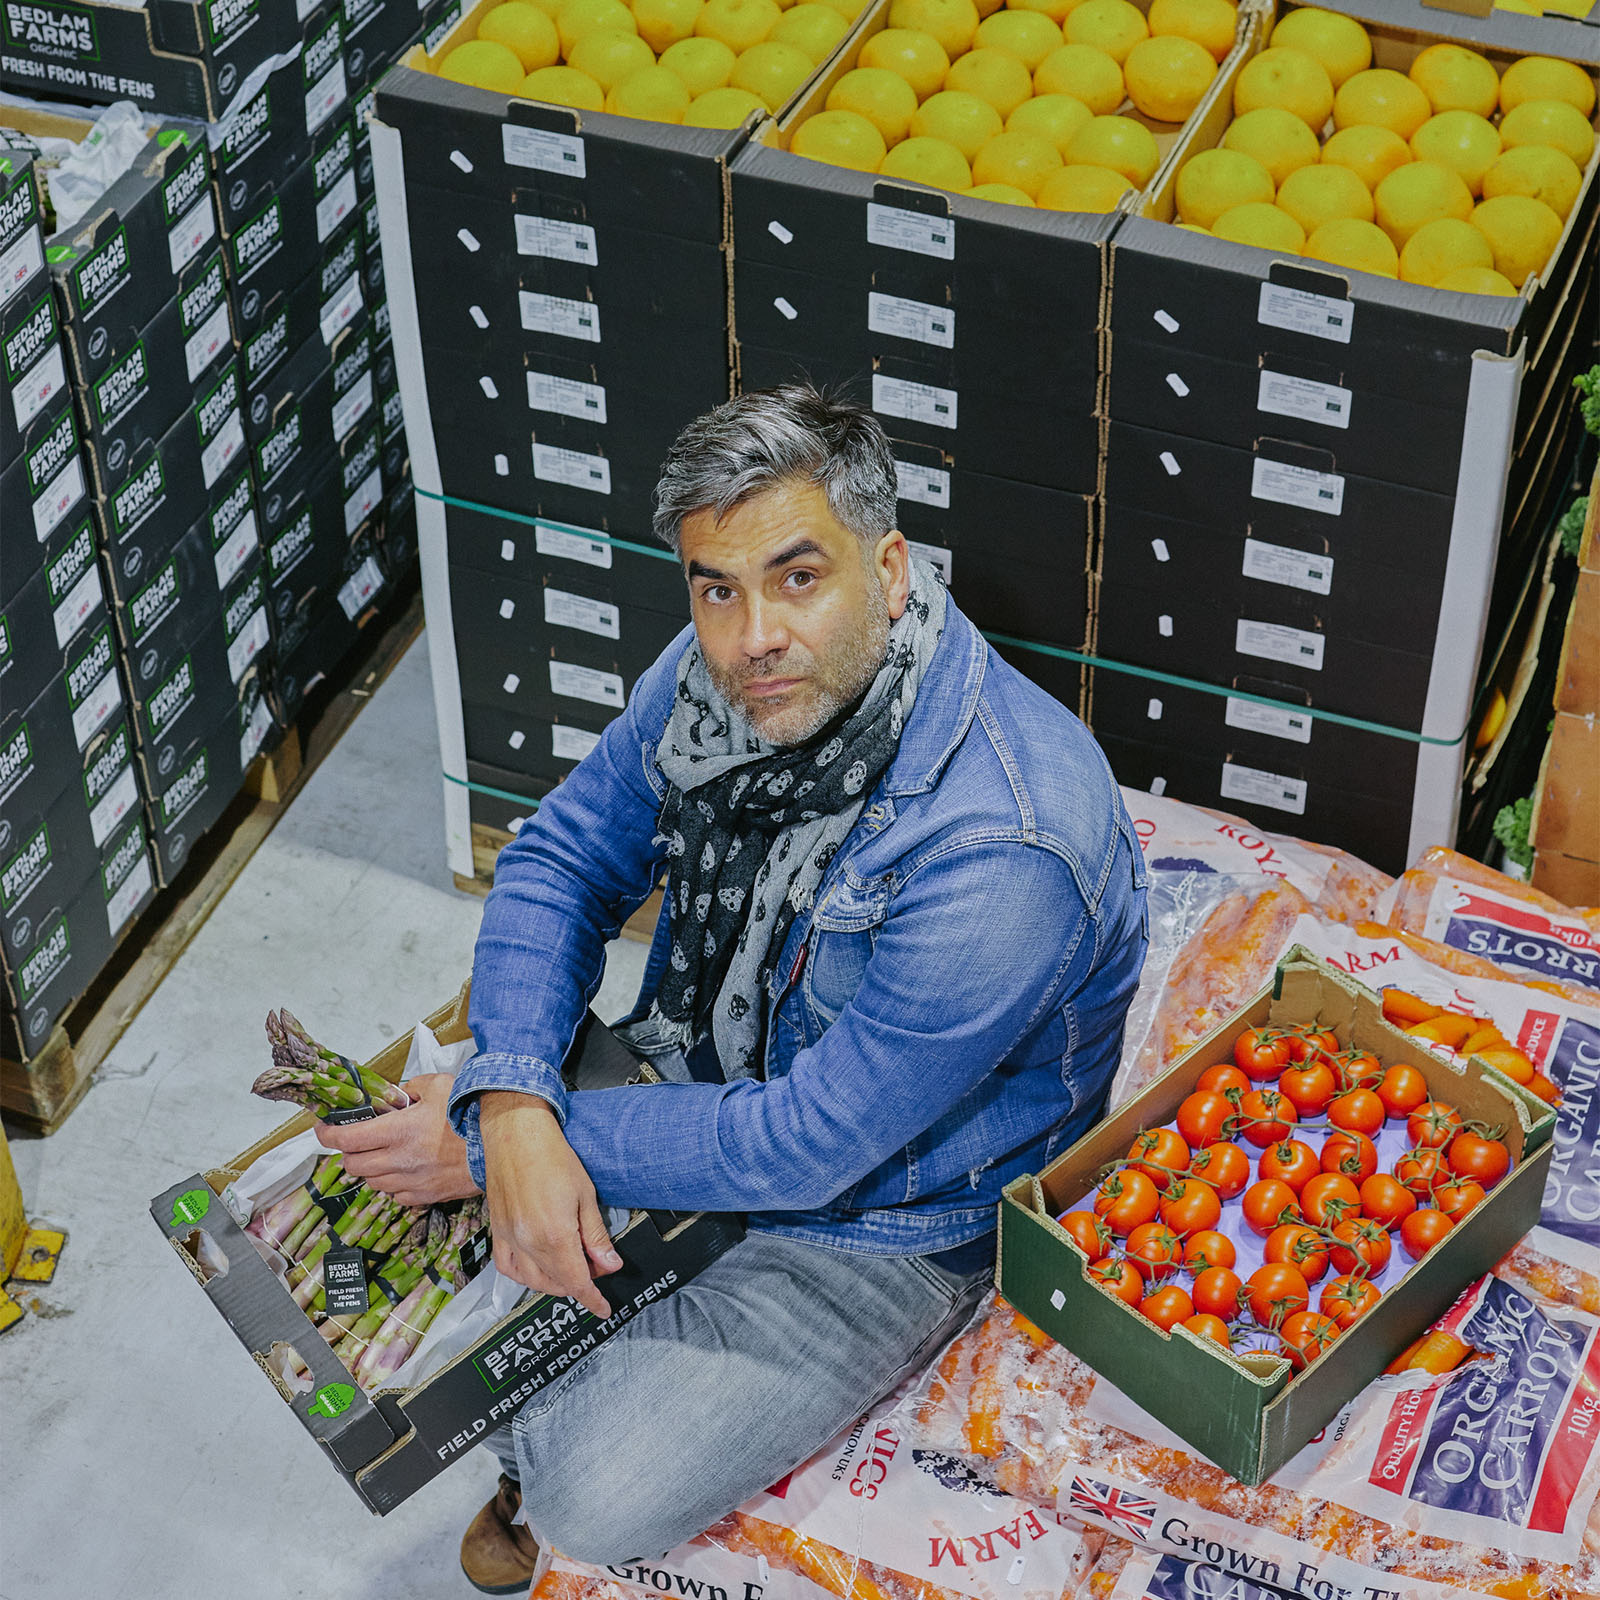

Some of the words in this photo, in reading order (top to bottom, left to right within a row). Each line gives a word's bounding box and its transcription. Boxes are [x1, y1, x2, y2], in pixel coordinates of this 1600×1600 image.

[7, 3, 89, 32] BEDLAM
[10, 20, 93, 51] FARMS
[29, 42, 77, 60] ORGANIC
[1, 56, 45, 78] FRESH
[48, 65, 86, 86] FROM
[89, 72, 116, 93] THE
[119, 78, 156, 99] FENS
[0, 182, 29, 221] DLAM
[168, 165, 206, 215] FARMS
[0, 195, 32, 238] ARMS
[80, 234, 124, 281] BEDLAM
[81, 251, 126, 300] FARMS
[6, 303, 50, 352] BEDLAM
[8, 317, 52, 371] FARMS
[98, 349, 142, 397] BEDLAM
[101, 361, 145, 414] FARMS
[29, 417, 71, 467] BEDLAM
[31, 434, 74, 485] FARMS
[115, 460, 159, 508] BEDLAM
[118, 472, 161, 524] FARMS
[48, 528, 89, 580] BEDLAM
[51, 543, 91, 595] FARMS
[68, 633, 109, 687] BEDLAM
[70, 649, 110, 700] FARMS
[0, 731, 25, 767] LAM
[0, 743, 28, 784] RMS
[88, 748, 126, 798] FARMS
[2, 831, 45, 885] BEDLAM
[4, 845, 47, 898] FARMS
[22, 925, 65, 978] BEDLAM
[23, 939, 67, 991] FARMS
[1467, 929, 1599, 979] RROTS
[1525, 1017, 1547, 1060] DUCE
[328, 1262, 359, 1271] BEDLAM
[329, 1269, 360, 1279] FARMS
[437, 1418, 487, 1460] FIELD
[488, 1373, 546, 1421] FRESH
[546, 1333, 594, 1377] FROM
[597, 1304, 633, 1336] THE
[633, 1269, 678, 1309] FENS
[520, 1324, 580, 1373] ORGANIC
[1568, 1396, 1600, 1438] 10kg
[1382, 1418, 1413, 1480] QUALITY
[928, 1510, 1048, 1567] FARM
[1161, 1518, 1280, 1584] Grown
